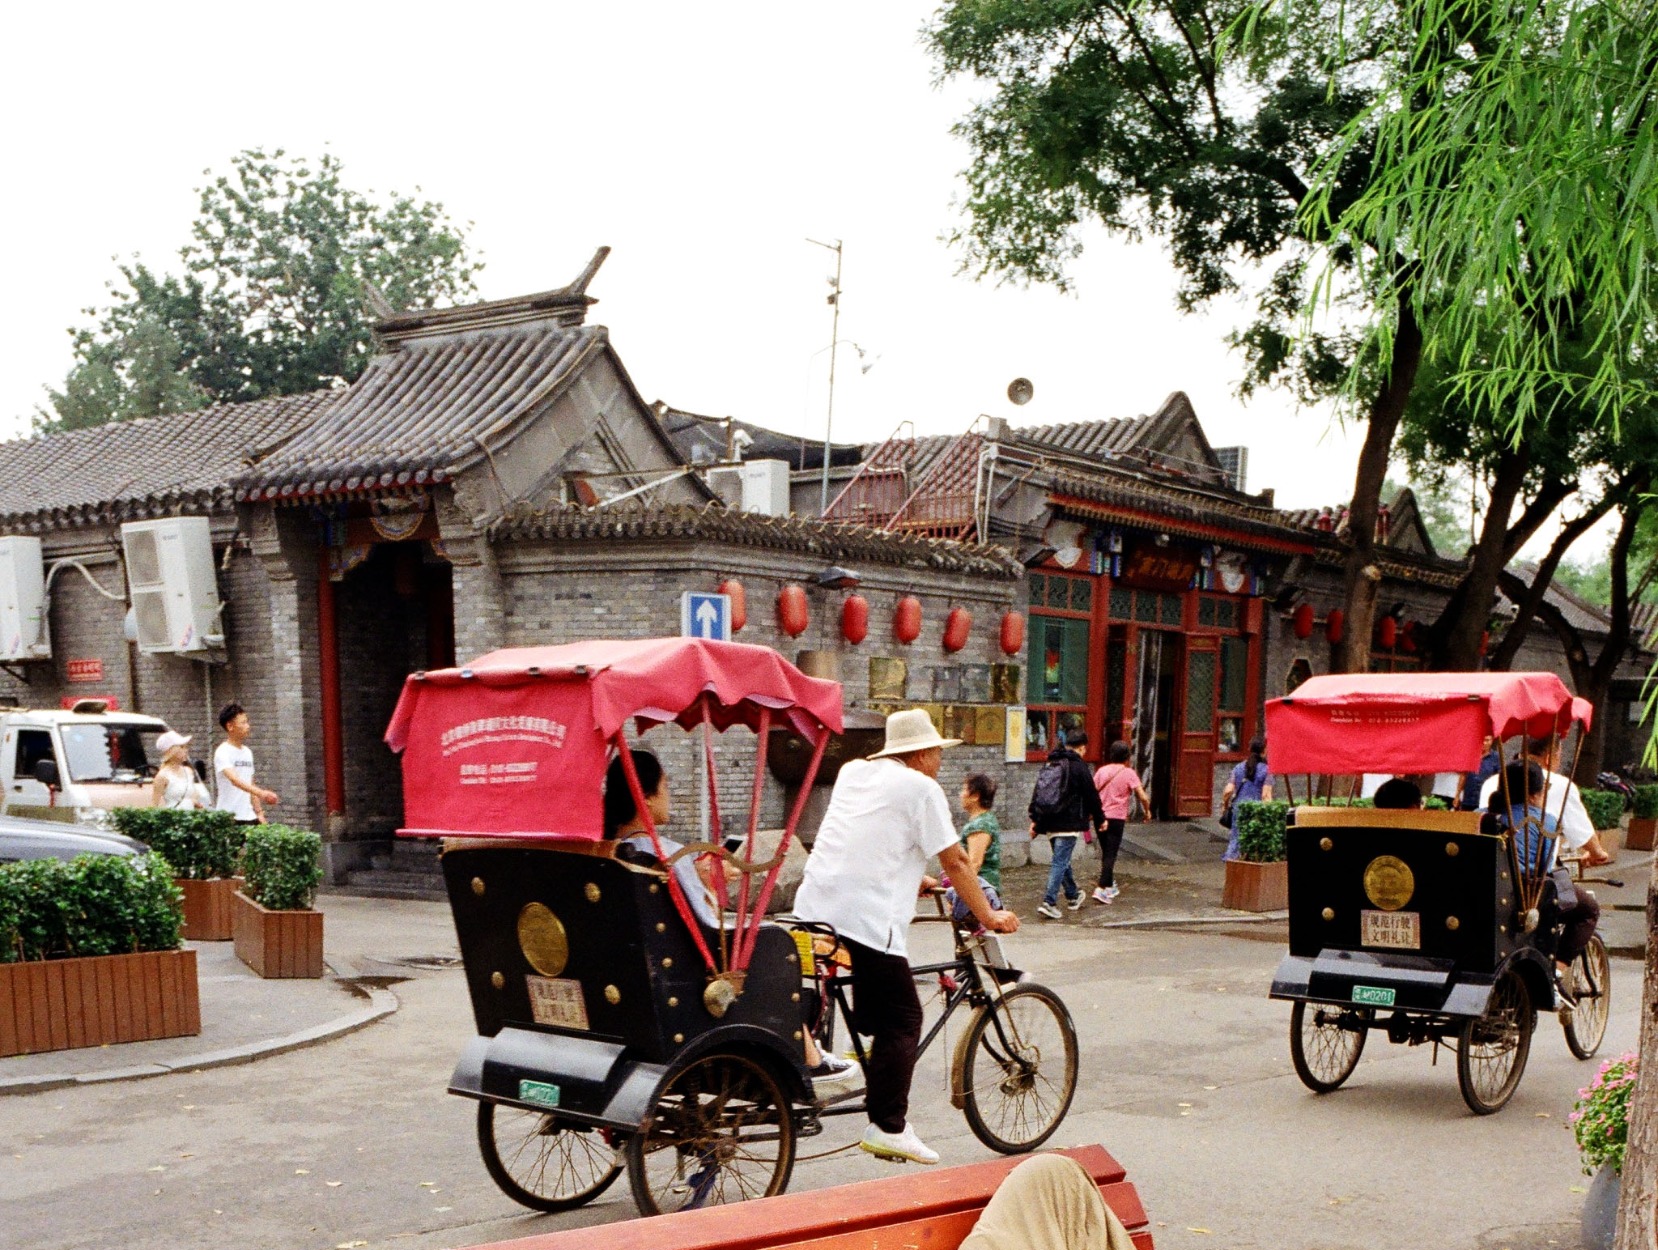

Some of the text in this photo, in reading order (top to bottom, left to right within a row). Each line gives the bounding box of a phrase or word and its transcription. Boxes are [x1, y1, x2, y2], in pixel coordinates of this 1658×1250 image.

[1370, 914, 1411, 929] 规范行驶
[1370, 929, 1411, 945] 文明礼让
